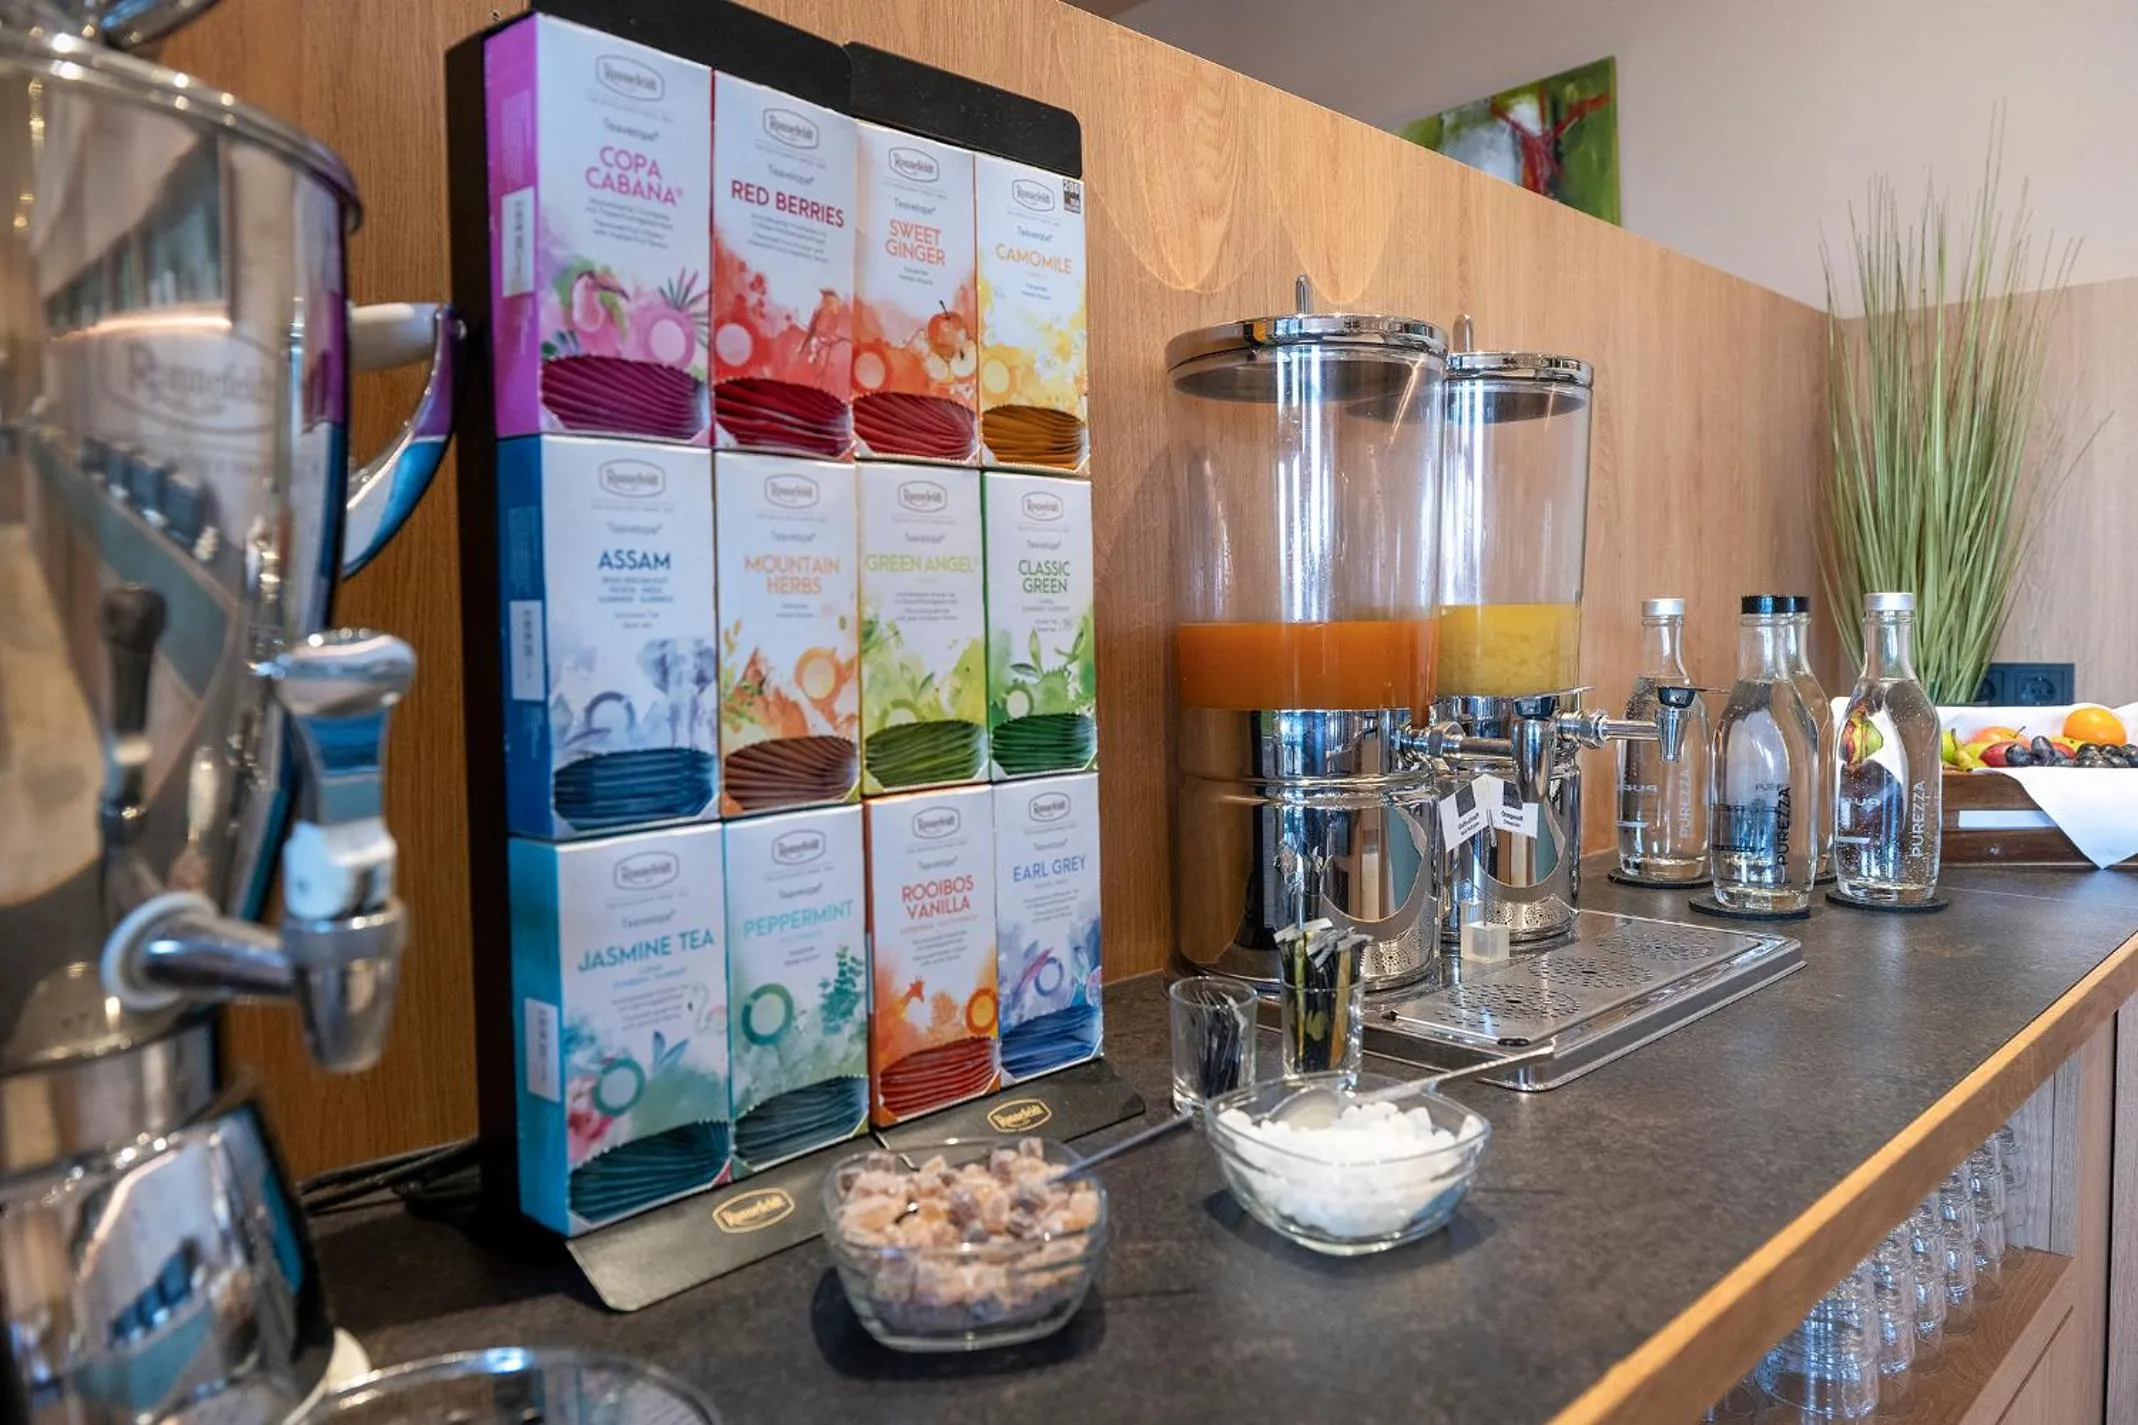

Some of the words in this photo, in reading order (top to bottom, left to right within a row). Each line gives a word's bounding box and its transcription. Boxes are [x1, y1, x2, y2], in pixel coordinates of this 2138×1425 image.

[600, 146, 661, 180] COPA
[731, 179, 769, 206] RED
[776, 191, 845, 228] BERRIES
[890, 219, 941, 246] SWEET
[885, 240, 946, 267] GINGER
[996, 243, 1072, 275] CAMOMILE
[598, 550, 671, 570] ASSAM
[744, 554, 839, 574] MOUNTAIN
[865, 554, 921, 571] GREEN
[1018, 559, 1071, 577] CLASSIC
[766, 577, 822, 595] HERBS
[1022, 578, 1068, 594] GREEN
[1679, 768, 1692, 839] PUREZZA
[1776, 786, 1791, 867] PUREZZA
[1909, 780, 1926, 857] PUREZZA
[1013, 862, 1049, 883] EARL
[1052, 854, 1087, 876] GREY
[902, 874, 975, 903] ROOIBOS
[743, 900, 854, 939] PEPPERMINT
[906, 896, 971, 921] VANILLA
[577, 936, 672, 972] JASMINE
[678, 928, 715, 951] TEA
